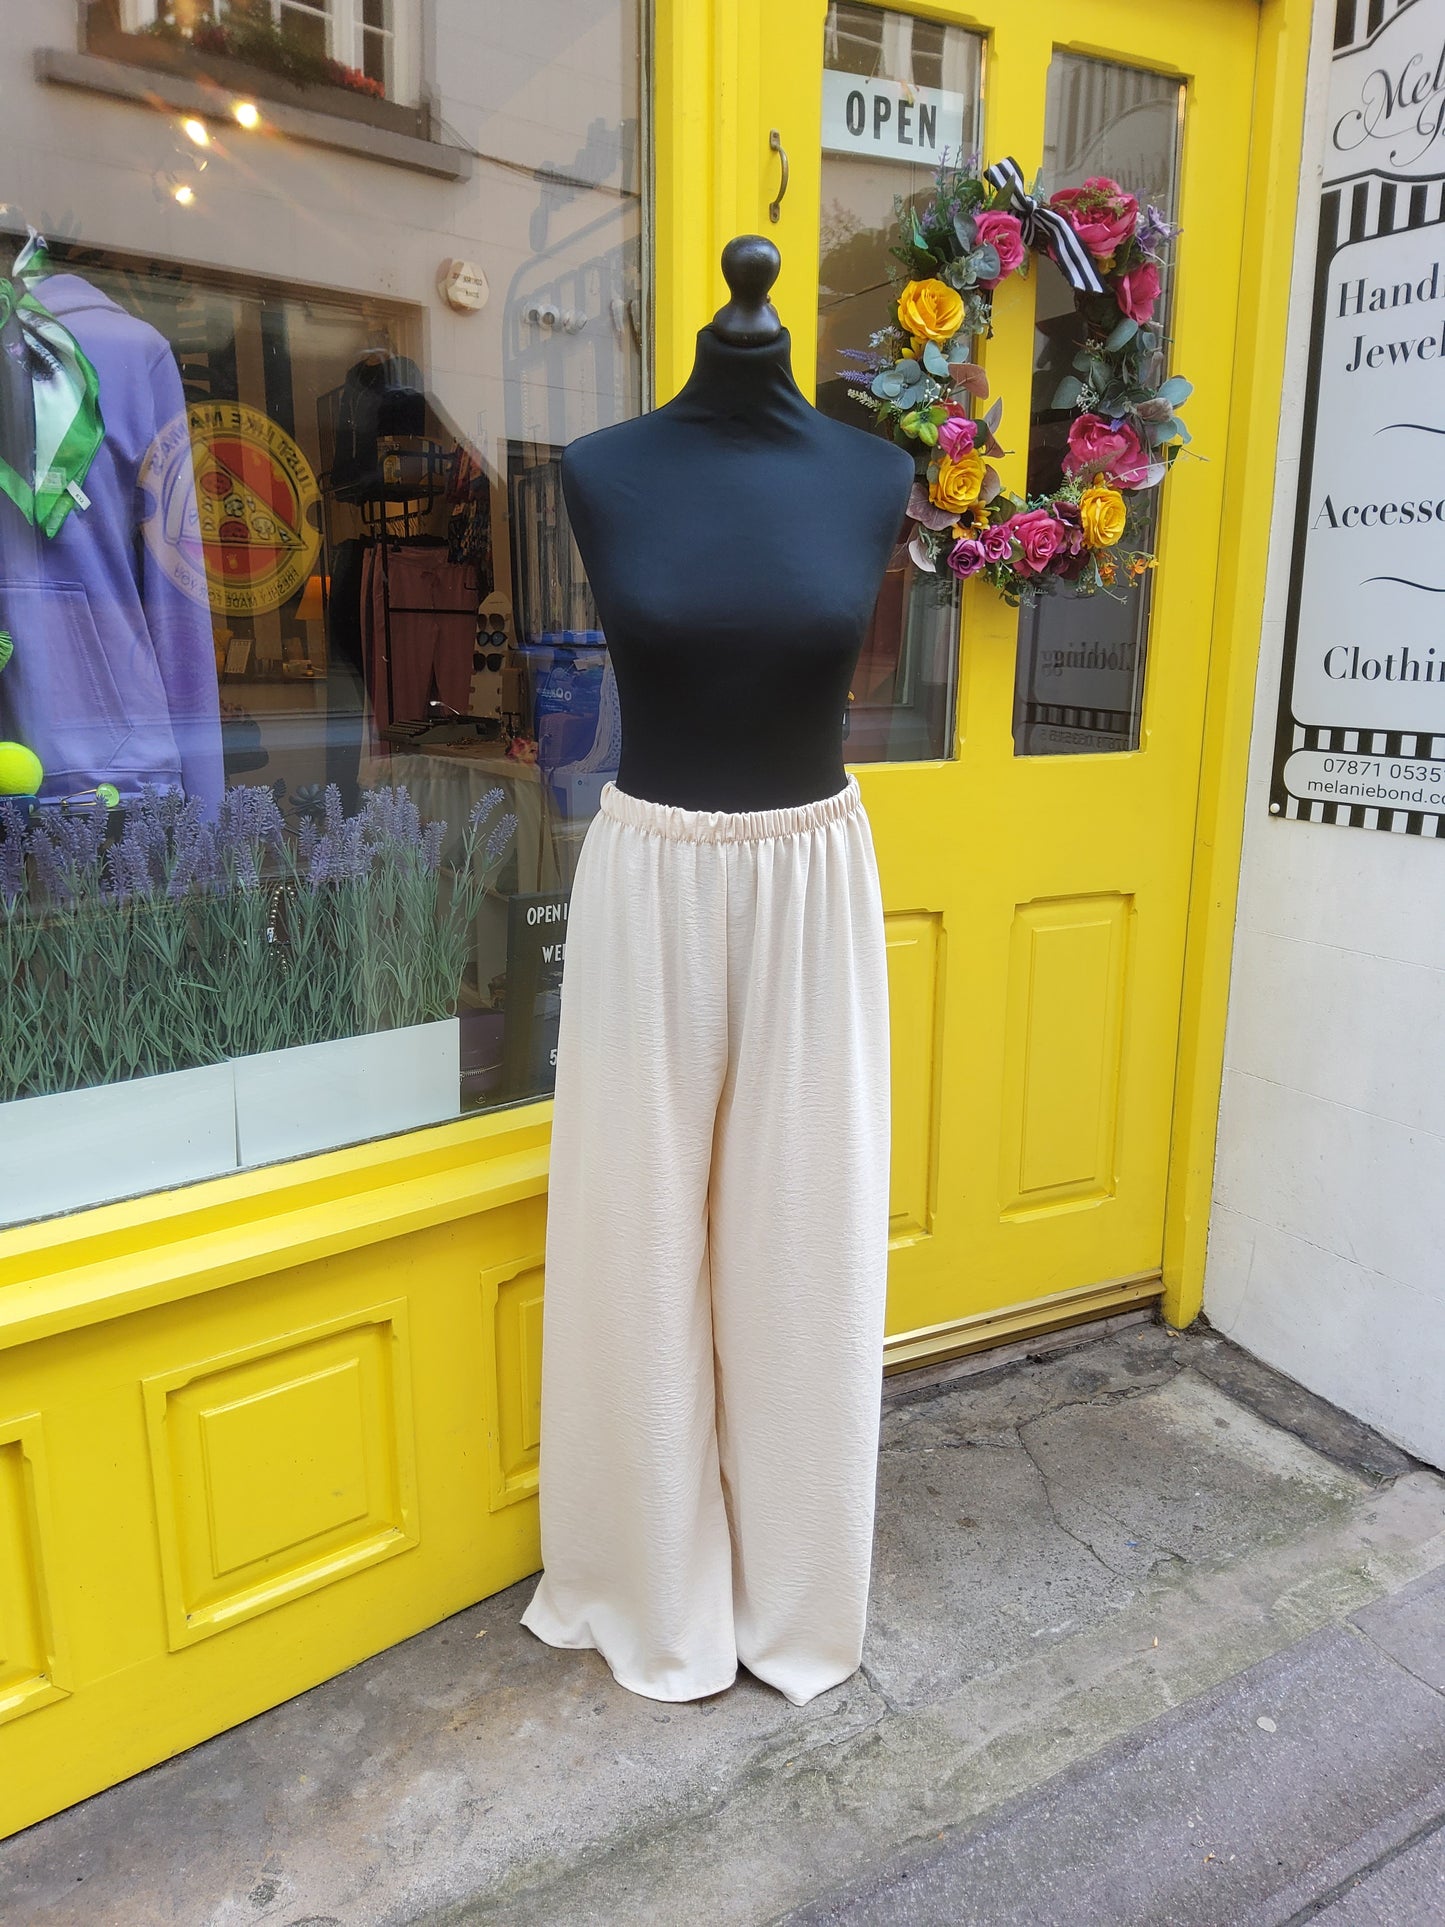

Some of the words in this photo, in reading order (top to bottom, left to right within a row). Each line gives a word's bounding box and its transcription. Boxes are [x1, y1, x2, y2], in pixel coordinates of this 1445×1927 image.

[845, 89, 937, 149] OPEN
[1335, 261, 1445, 319] Hand
[1323, 758, 1381, 777] 07871
[1390, 764, 1445, 783] 0535
